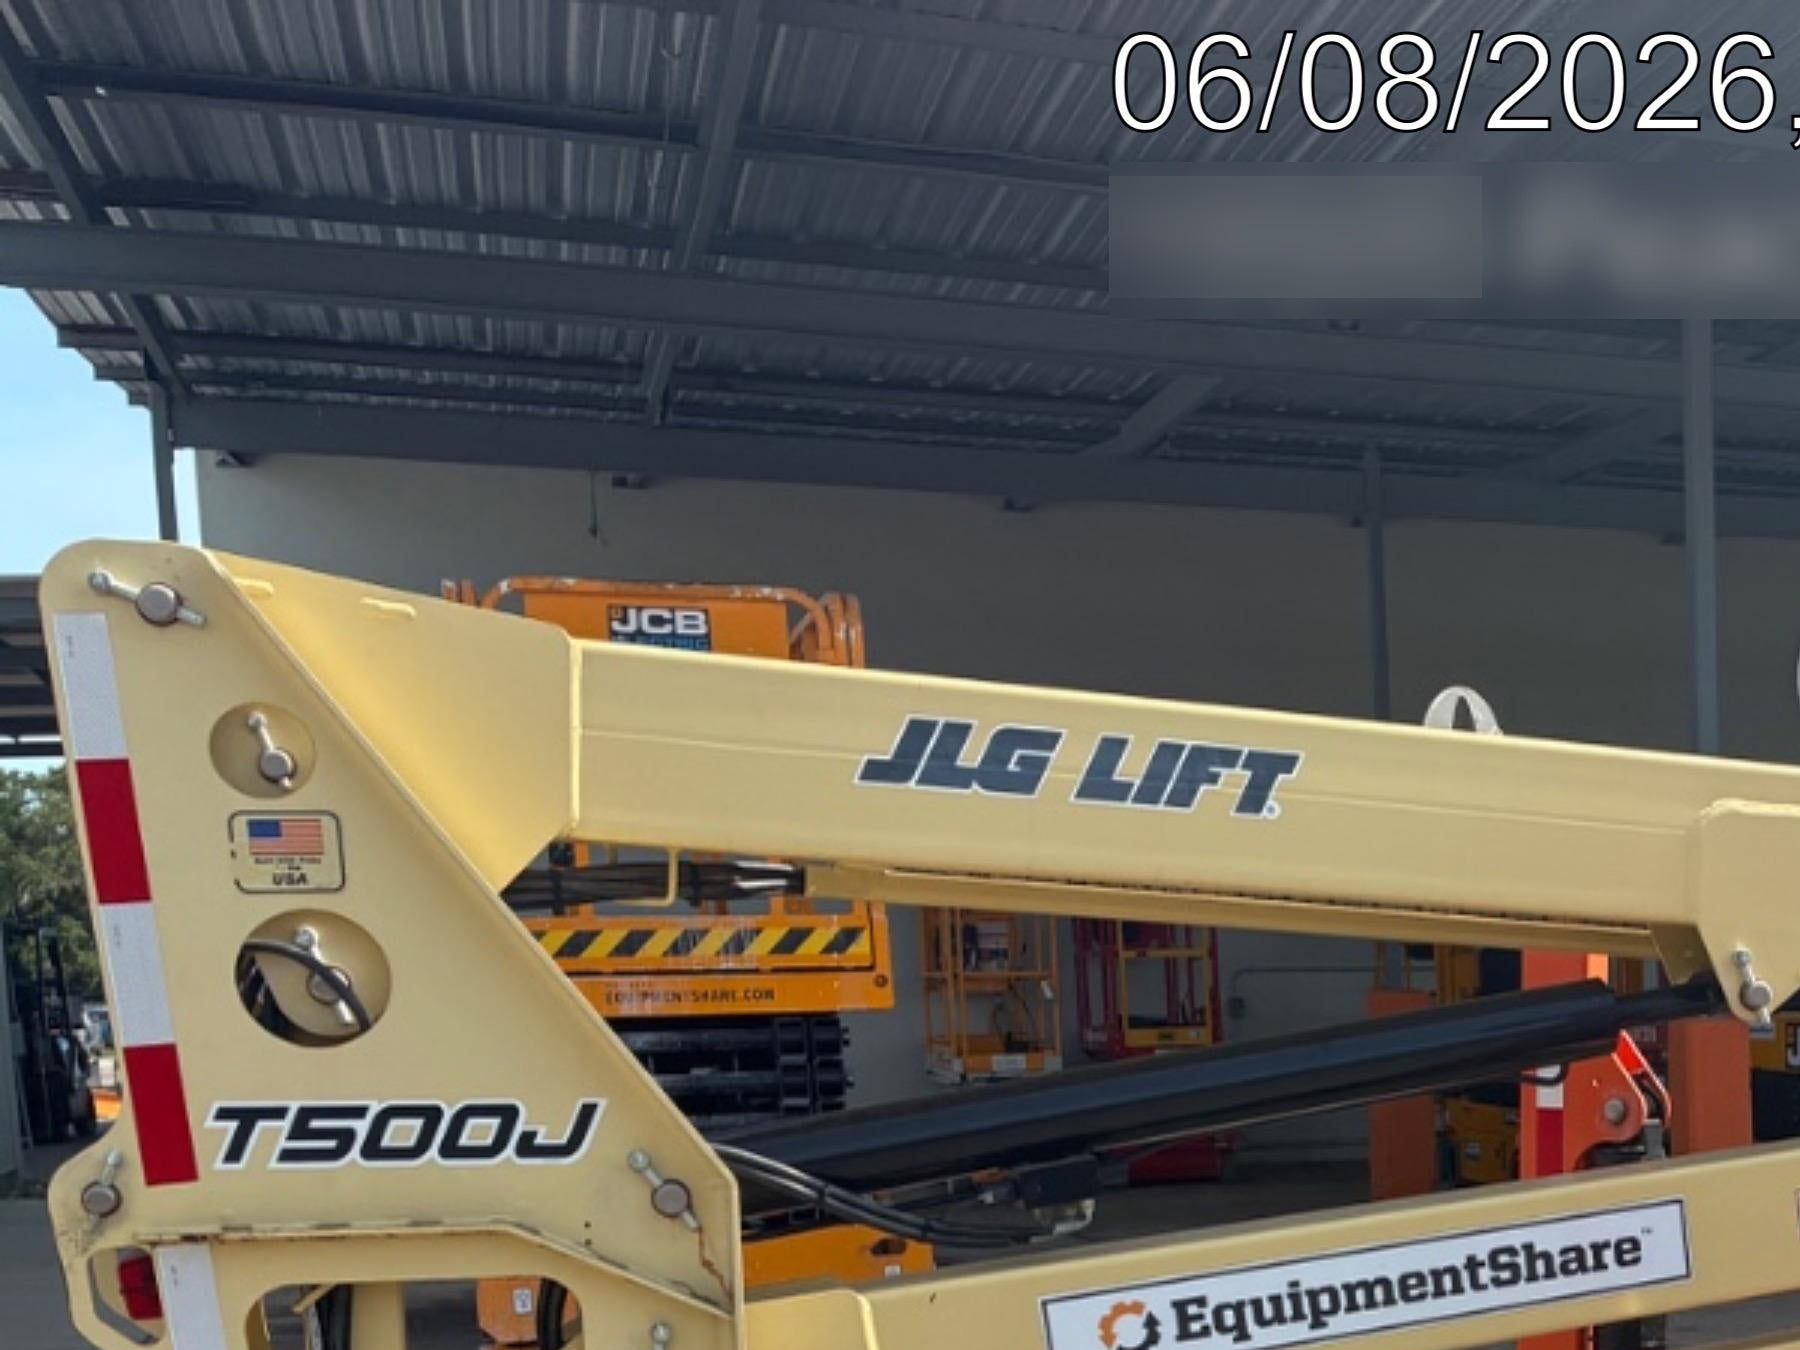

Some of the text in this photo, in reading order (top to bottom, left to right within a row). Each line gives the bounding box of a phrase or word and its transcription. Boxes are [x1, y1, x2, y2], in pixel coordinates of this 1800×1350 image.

[610, 606, 708, 634] JCB
[855, 714, 1305, 818] JLG LIFT
[197, 1099, 605, 1169] T500J
[1171, 1232, 1643, 1344] EquipmentShare
